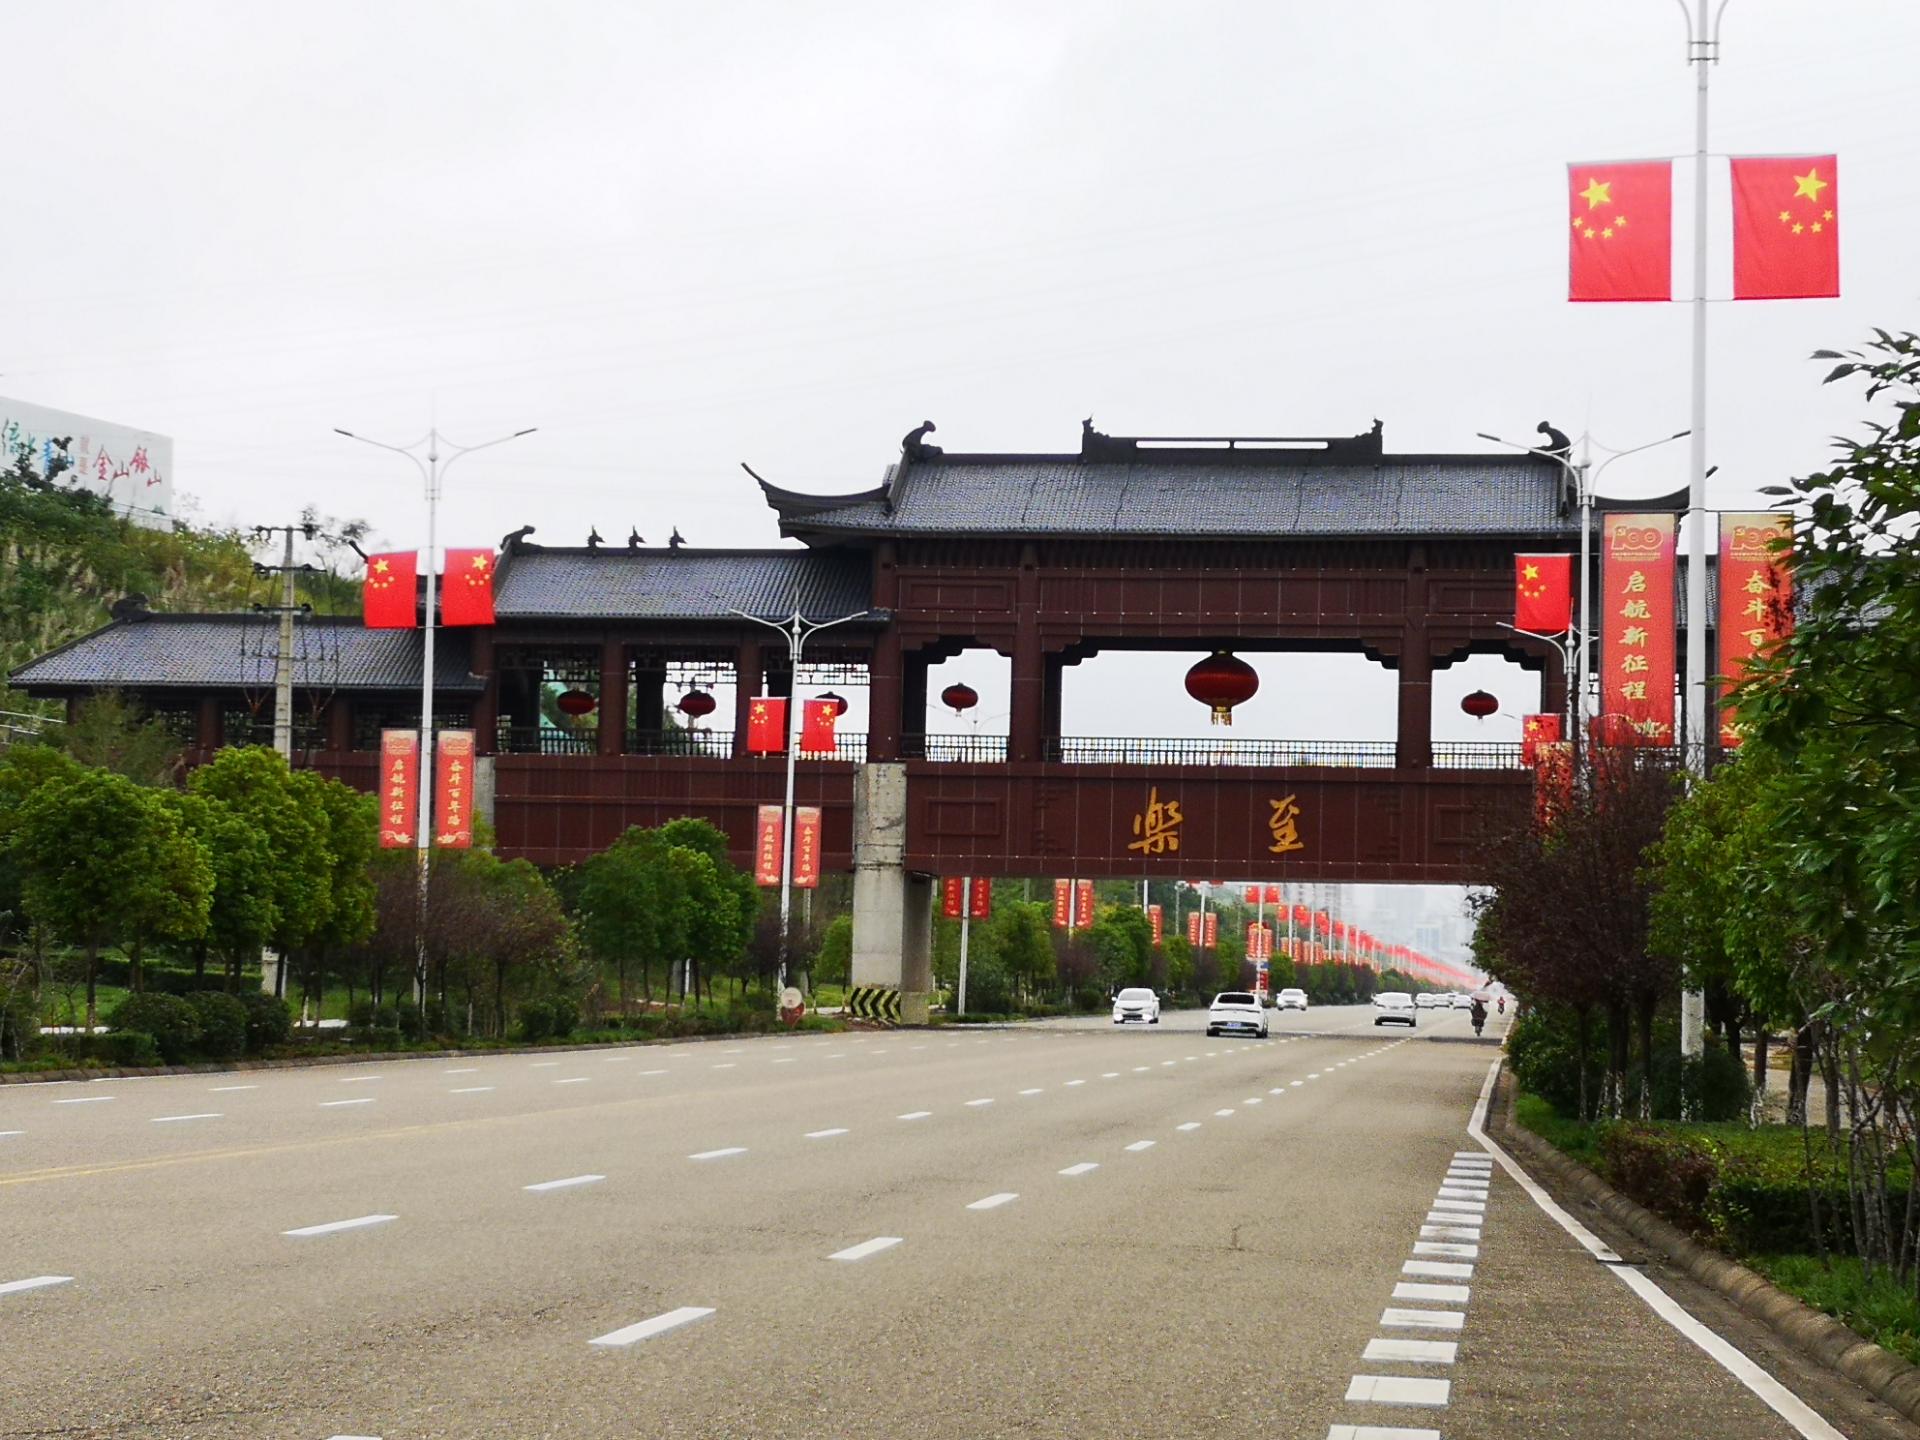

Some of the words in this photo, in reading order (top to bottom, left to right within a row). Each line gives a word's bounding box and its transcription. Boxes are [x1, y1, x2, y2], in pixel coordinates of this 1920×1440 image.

[1618, 570, 1651, 701] 启航新征程
